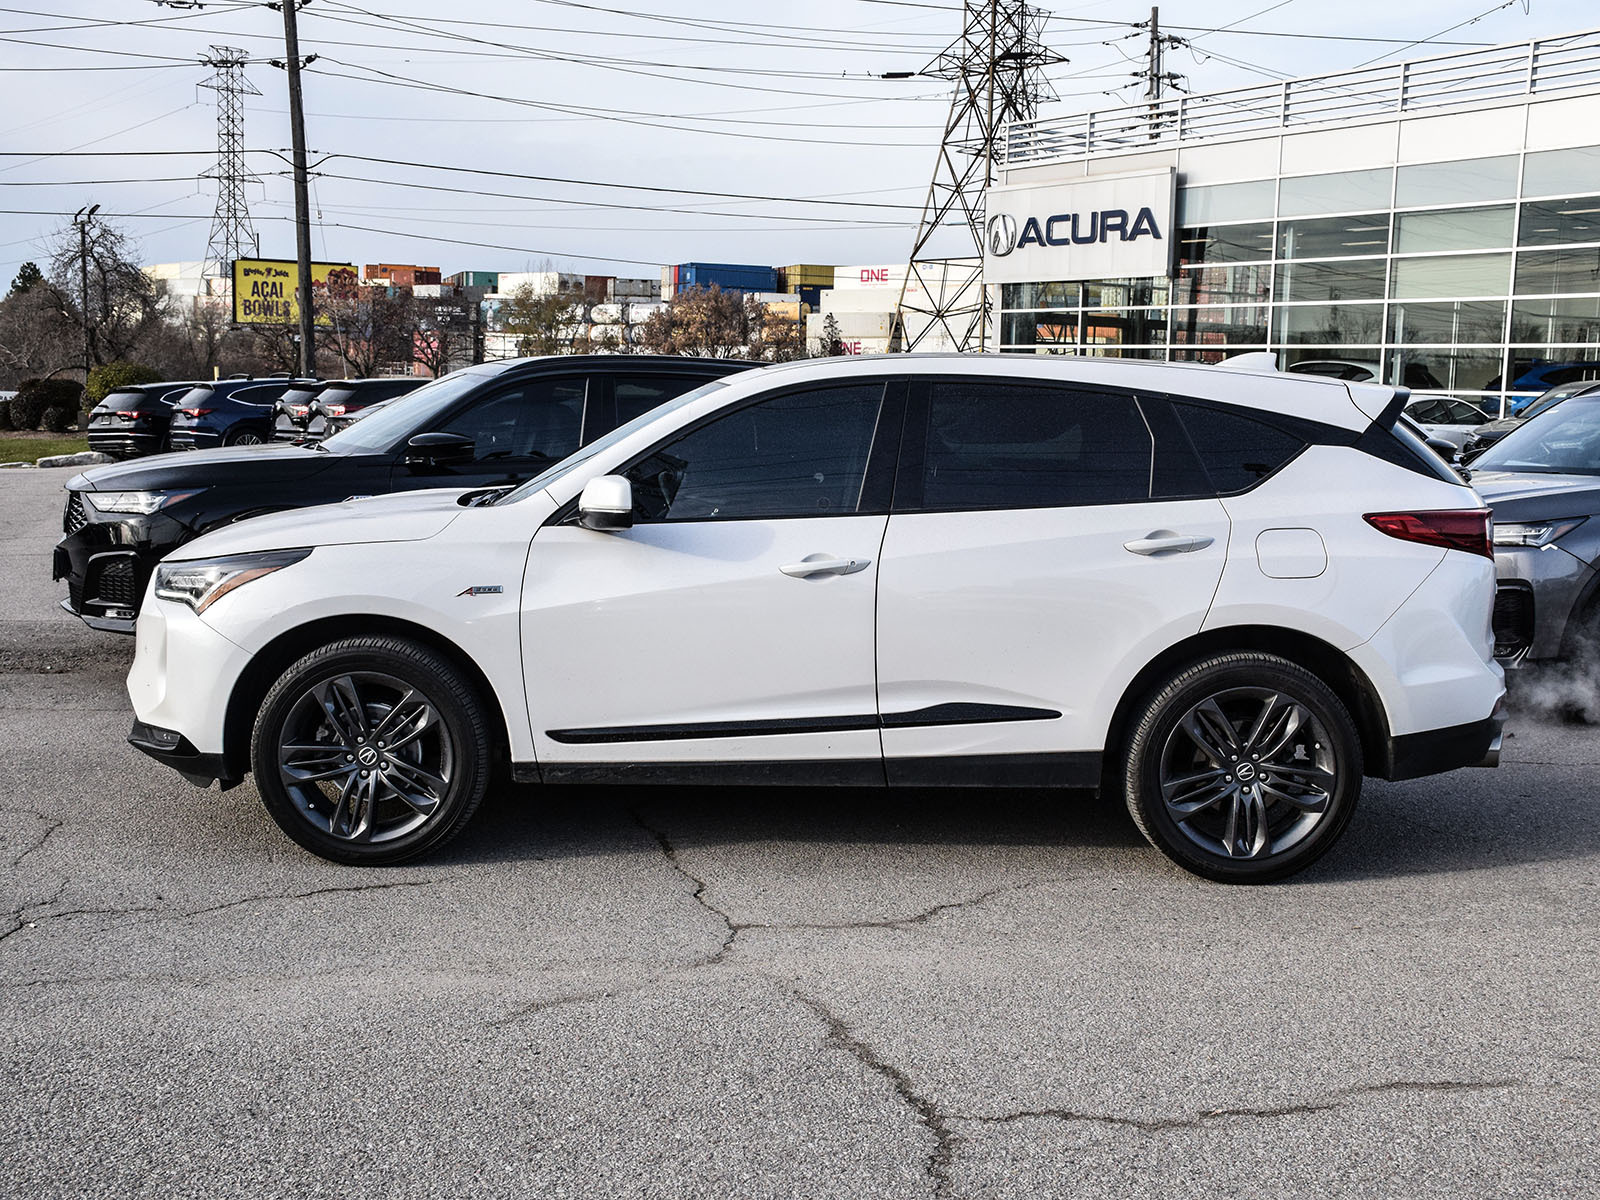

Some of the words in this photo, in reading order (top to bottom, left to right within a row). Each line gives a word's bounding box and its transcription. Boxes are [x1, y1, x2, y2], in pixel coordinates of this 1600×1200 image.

[1016, 207, 1162, 249] ACURA
[860, 268, 889, 282] ONE
[251, 280, 284, 301] AÇAI
[243, 299, 291, 317] BOWLS
[840, 341, 862, 356] NE
